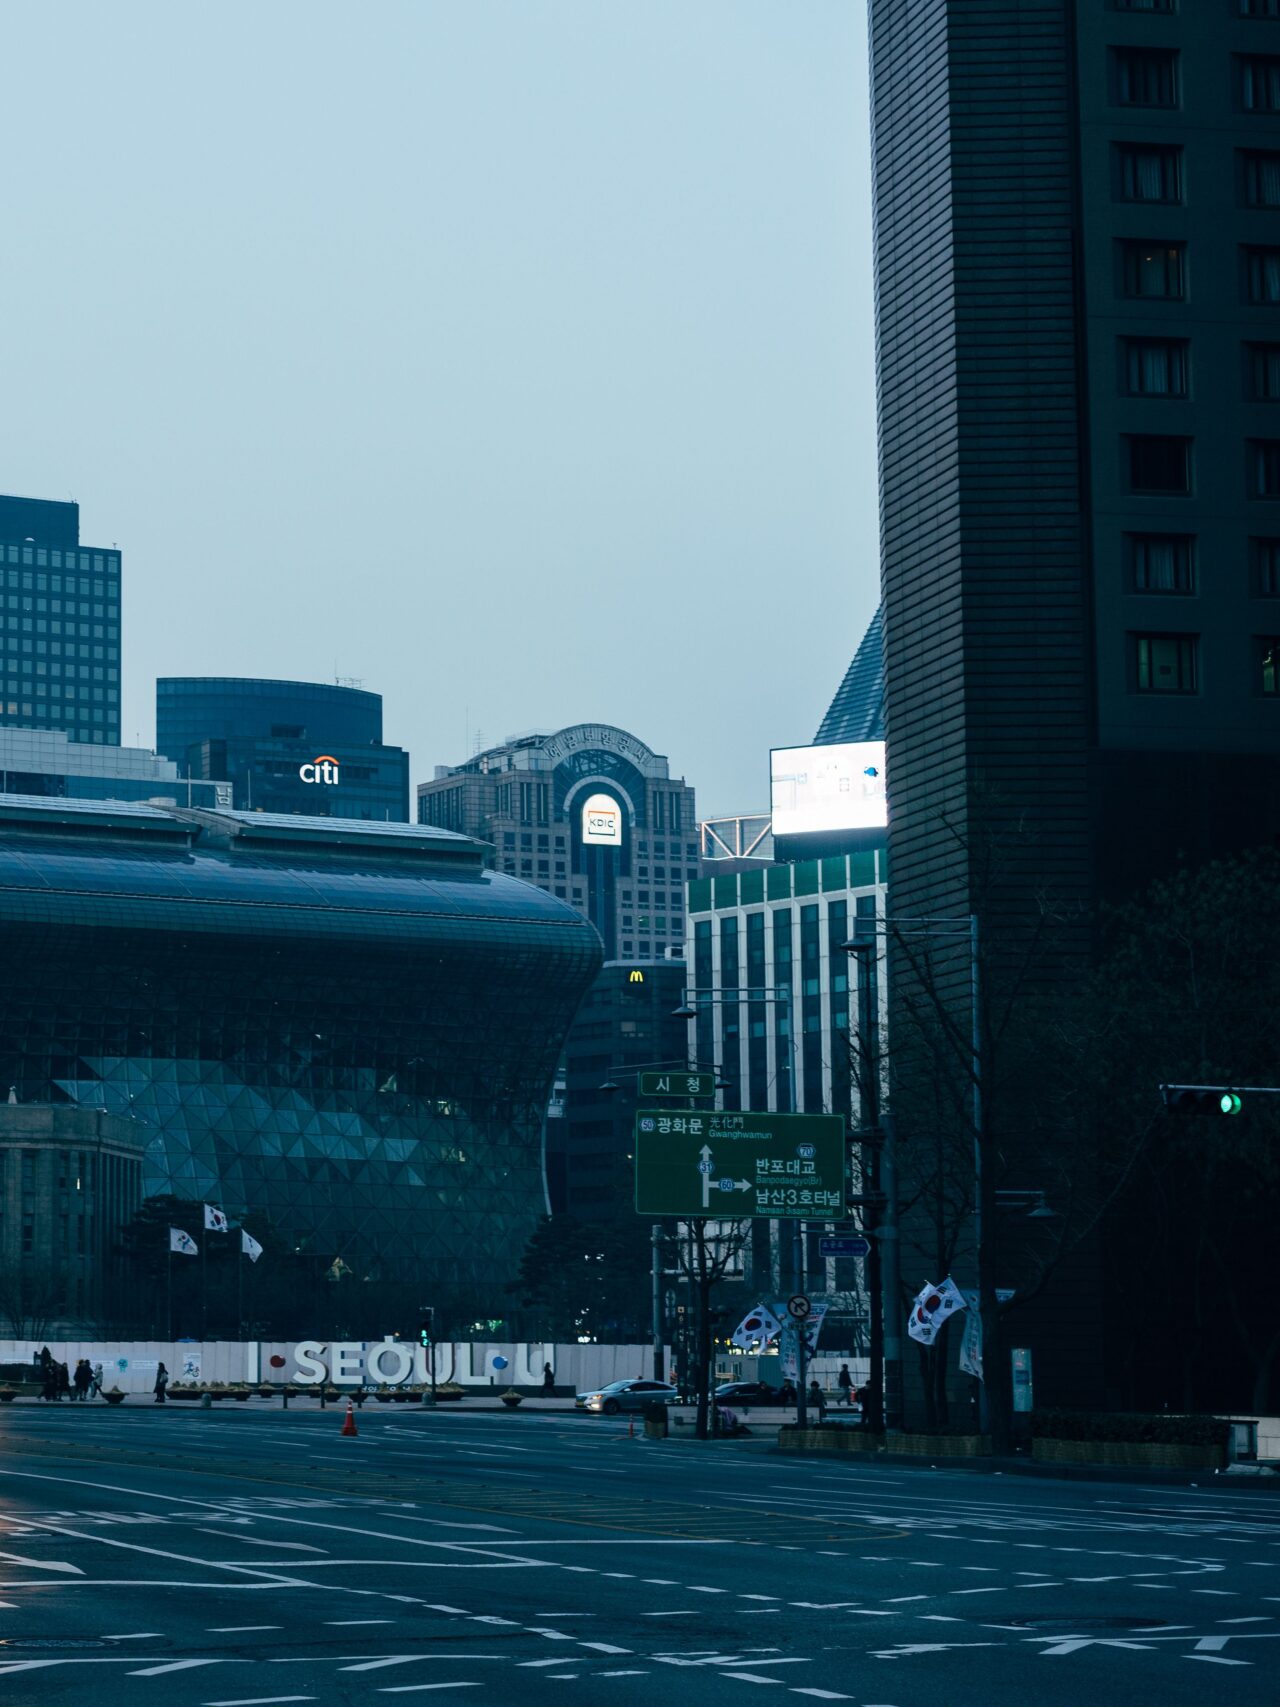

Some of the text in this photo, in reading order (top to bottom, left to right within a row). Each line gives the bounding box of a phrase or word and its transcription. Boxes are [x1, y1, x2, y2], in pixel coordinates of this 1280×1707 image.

[299, 758, 340, 785] citi
[589, 818, 614, 828] KDIC
[640, 1121, 654, 1130] 50
[657, 1117, 703, 1135] 광화문
[708, 1129, 773, 1140] Gwanghwamun
[801, 1147, 812, 1156] 70
[702, 1163, 713, 1172] 31
[756, 1158, 816, 1175] 반포대교
[721, 1180, 732, 1189] 60
[756, 1189, 840, 1207] 남산3호터널
[811, 1207, 834, 1216] Tunnel
